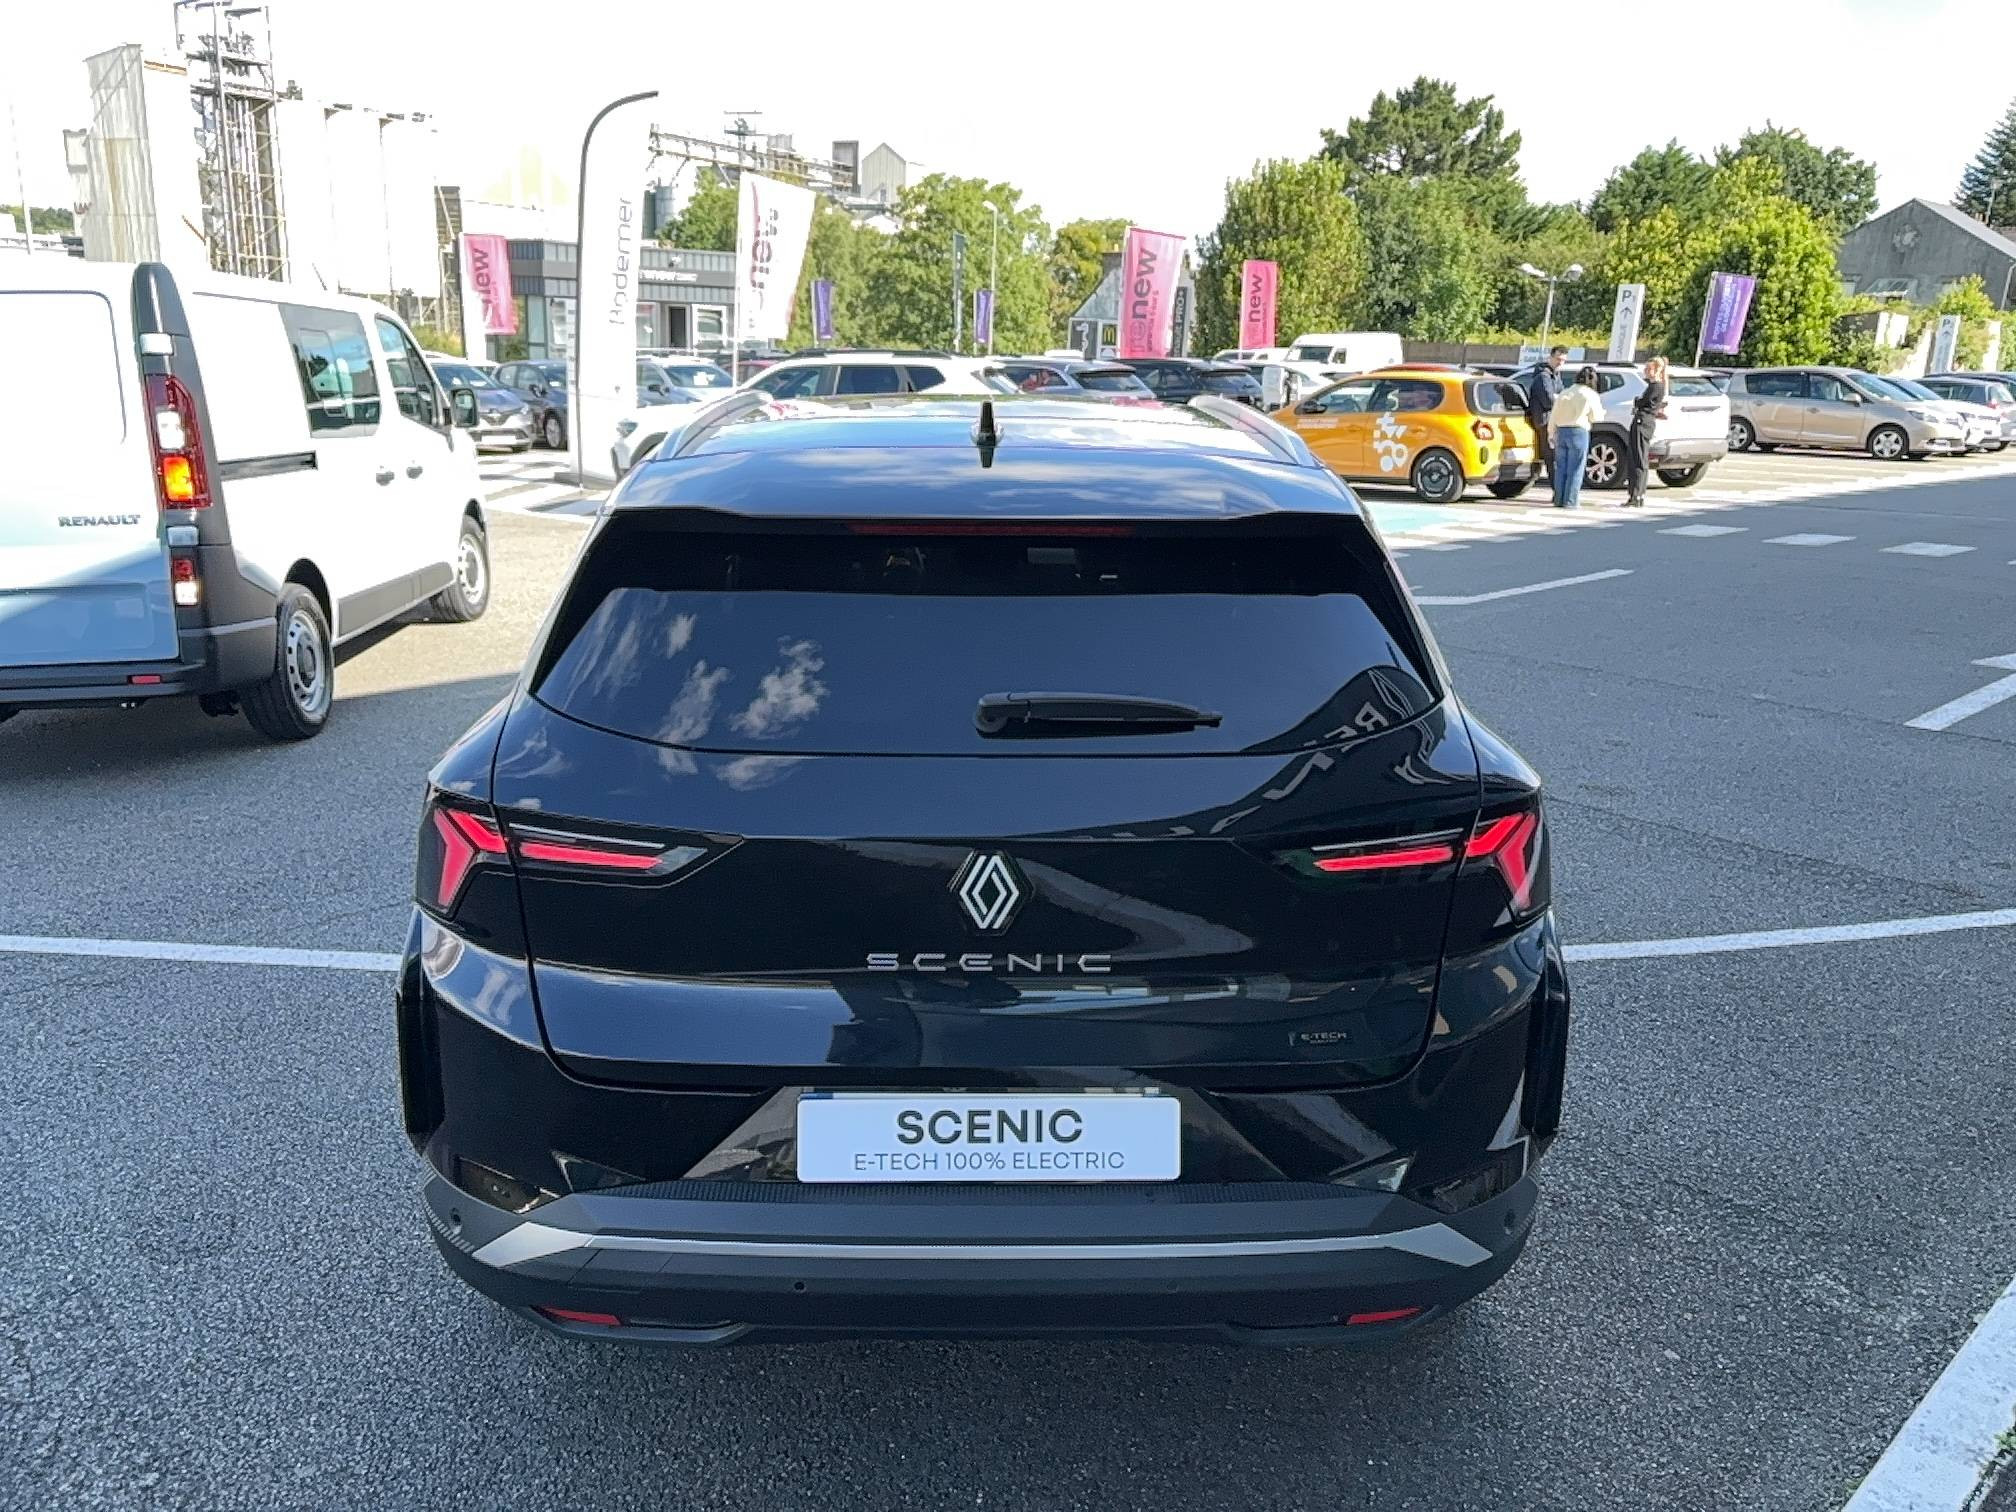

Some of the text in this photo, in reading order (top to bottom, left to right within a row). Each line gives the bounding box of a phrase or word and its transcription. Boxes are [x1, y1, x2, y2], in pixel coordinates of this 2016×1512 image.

[1129, 248, 1157, 353] renew
[58, 514, 141, 527] RENAULT
[866, 953, 1112, 972] SCENIC
[1301, 1032, 1347, 1041] E-TECH
[897, 1109, 1083, 1144] SCENIC
[854, 1151, 1125, 1170] E-TECH 100% ELECTRIC
